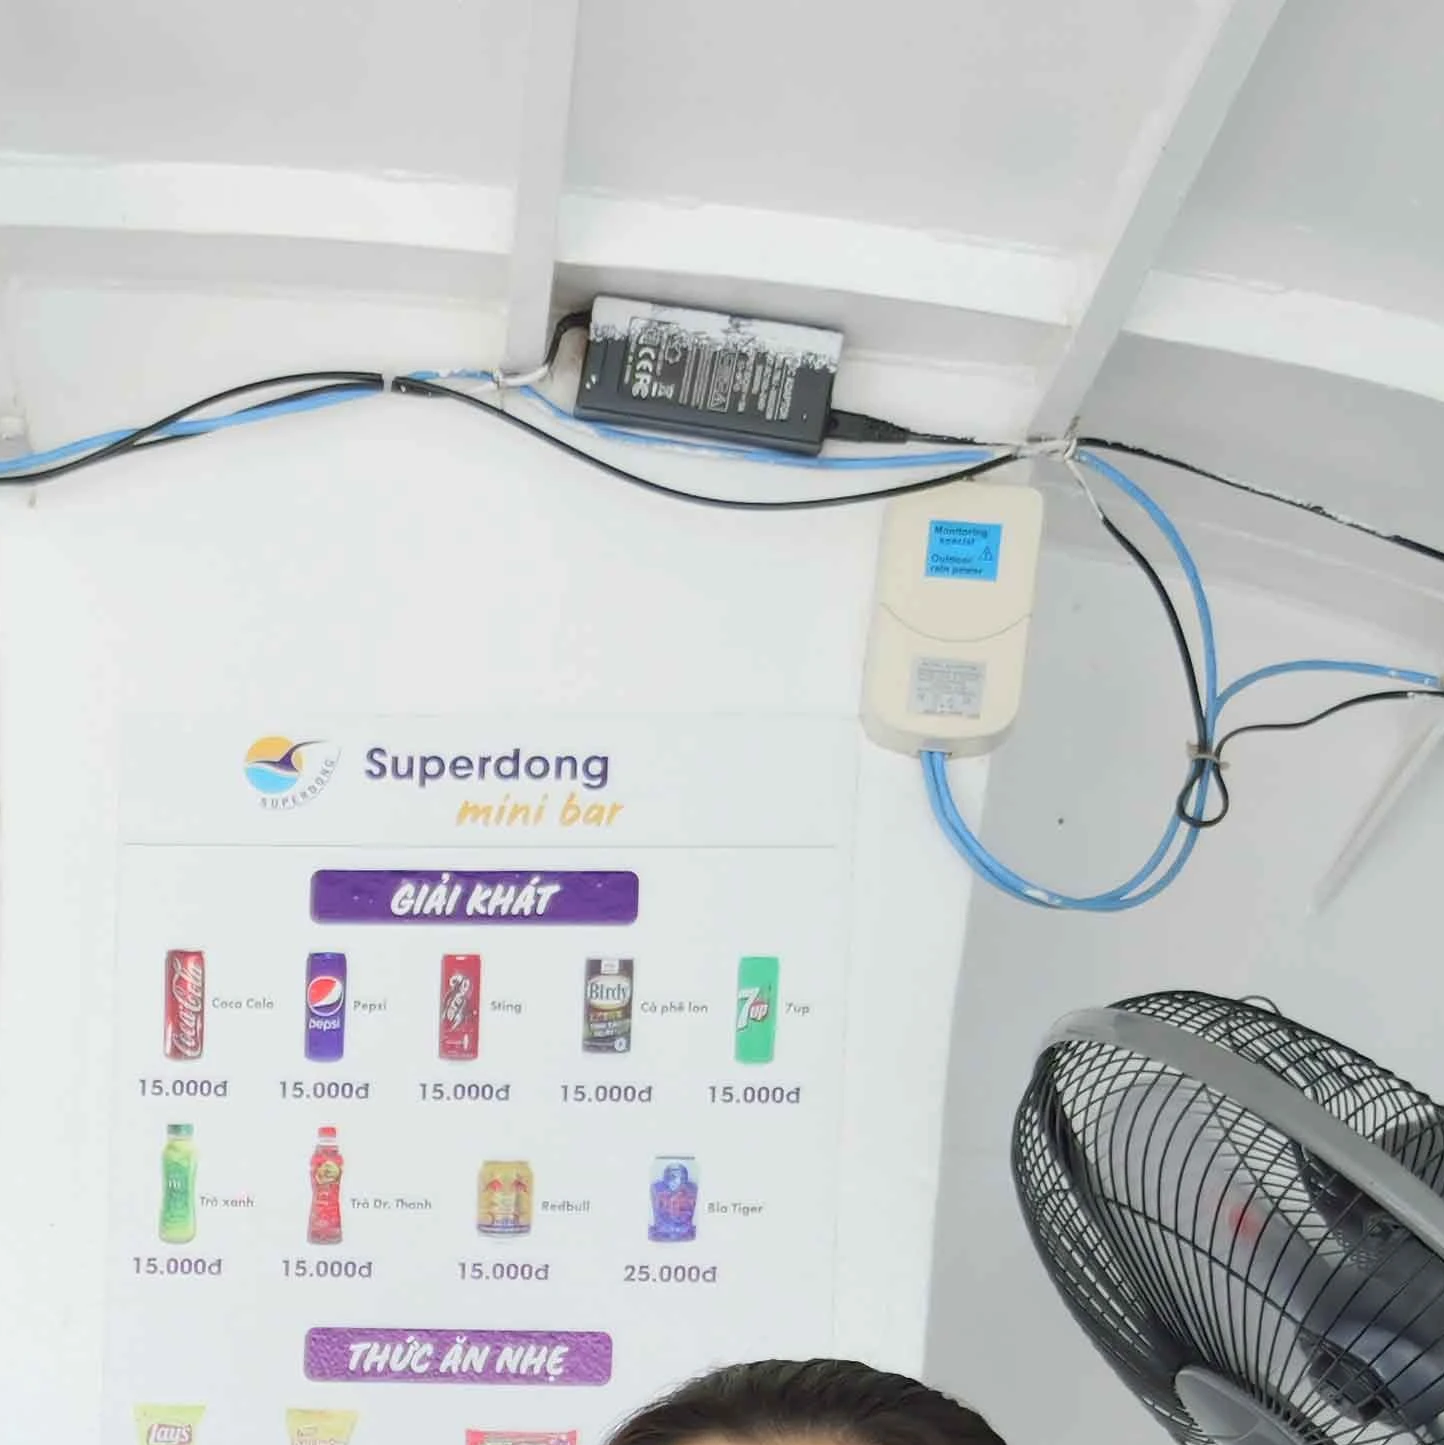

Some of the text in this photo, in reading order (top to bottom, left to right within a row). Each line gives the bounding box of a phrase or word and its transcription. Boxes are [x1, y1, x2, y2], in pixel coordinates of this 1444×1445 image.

[364, 746, 610, 790] Superdong
[455, 791, 625, 827] mini bar
[389, 872, 563, 918] GIẢI KHÁT
[211, 997, 275, 1010] Coca Cola
[353, 999, 387, 1013] Pepsi
[490, 1000, 523, 1015] Sting
[688, 1000, 709, 1015] lon
[785, 1002, 811, 1017] 7up
[308, 1017, 342, 1033] pepsi
[138, 1079, 229, 1098] 15.000đ
[279, 1081, 370, 1100] 15.000đ
[419, 1083, 511, 1102] 15.000đ
[561, 1084, 653, 1103] 15.000đ
[708, 1085, 801, 1105] 15.000đ
[222, 1196, 255, 1208] xanh
[540, 1200, 591, 1214] Redbull
[707, 1202, 728, 1214] Bia
[731, 1202, 764, 1216] Tiger
[132, 1257, 223, 1276] 15.000đ
[281, 1259, 373, 1279] 15.000đ
[458, 1262, 550, 1281] 15.000đ
[623, 1265, 718, 1284] 25.000đ
[348, 1335, 570, 1383] THỨC ĂN NHẸ
